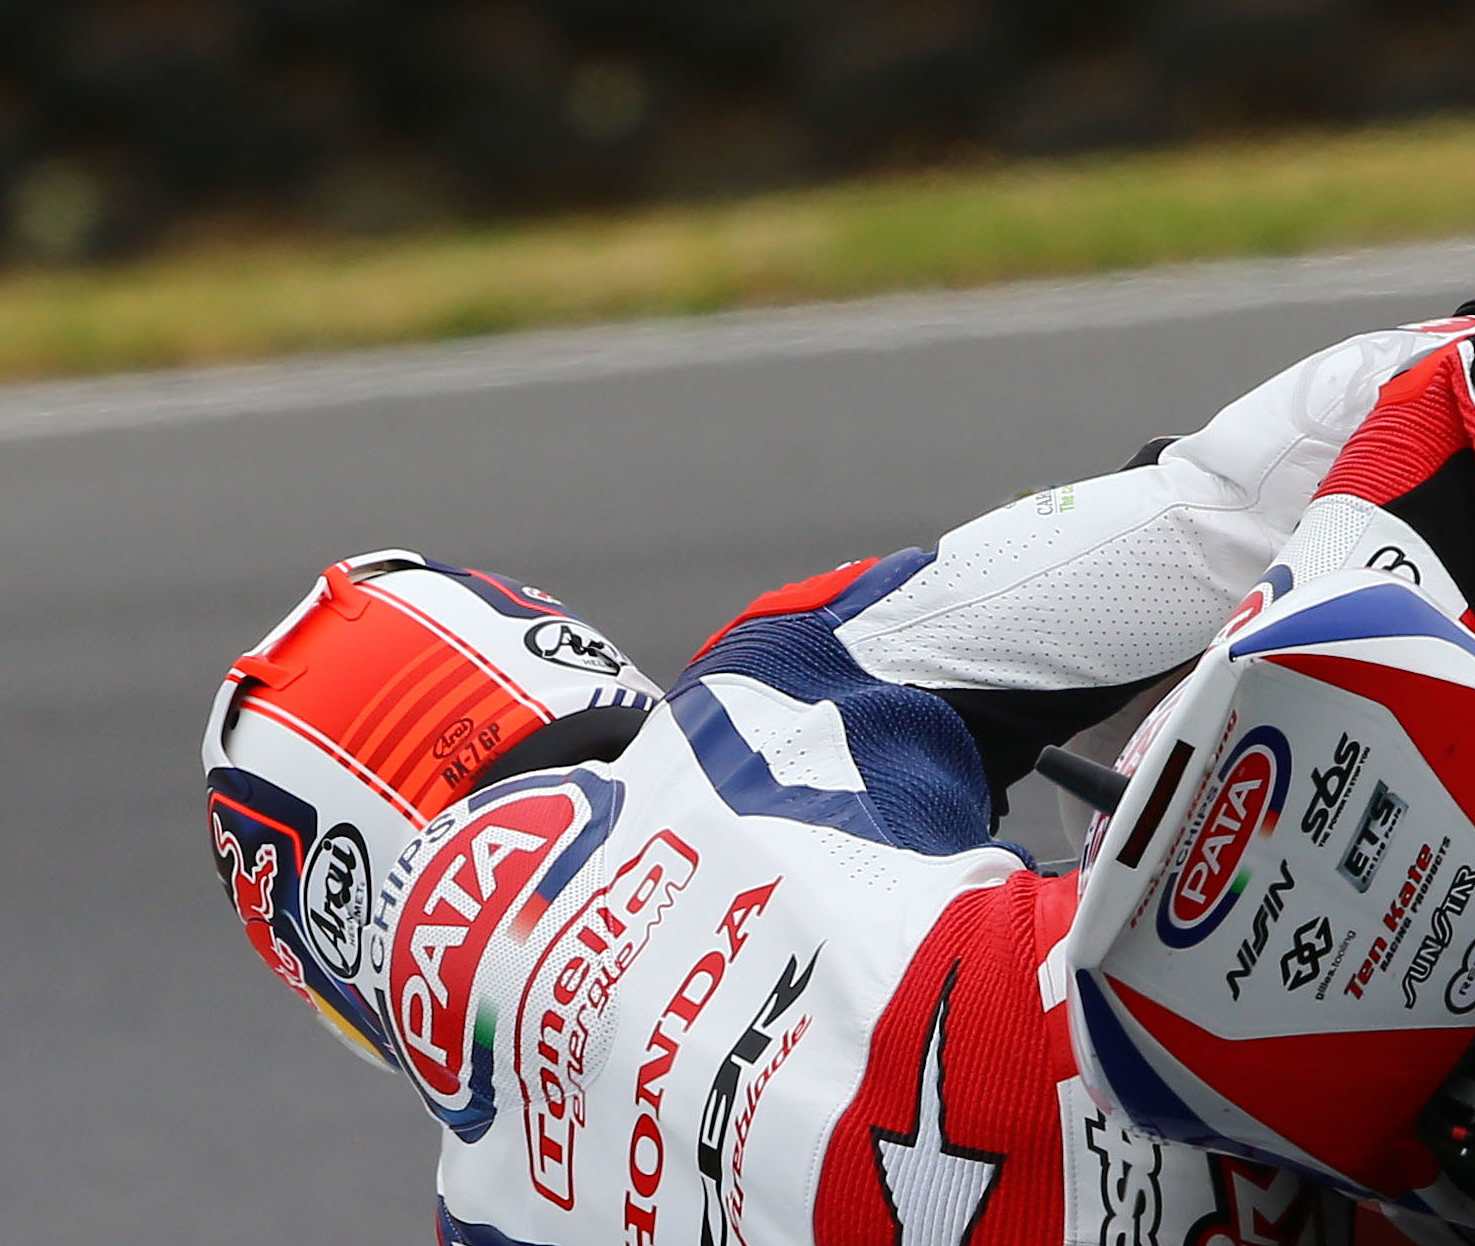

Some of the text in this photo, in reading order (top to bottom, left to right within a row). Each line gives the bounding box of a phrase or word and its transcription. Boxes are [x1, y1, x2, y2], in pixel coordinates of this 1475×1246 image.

[478, 723, 501, 751] GP
[369, 811, 455, 975] CHIPS
[1175, 785, 1218, 866] CHIPS
[1180, 778, 1264, 905] PATA
[1344, 792, 1396, 877] ETS
[310, 838, 357, 976] Arai
[399, 823, 549, 1070] PATA
[1344, 843, 1433, 1000] Ten Kate
[1380, 836, 1451, 972] RACING PRODUCTS
[535, 862, 663, 1175] Tonello
